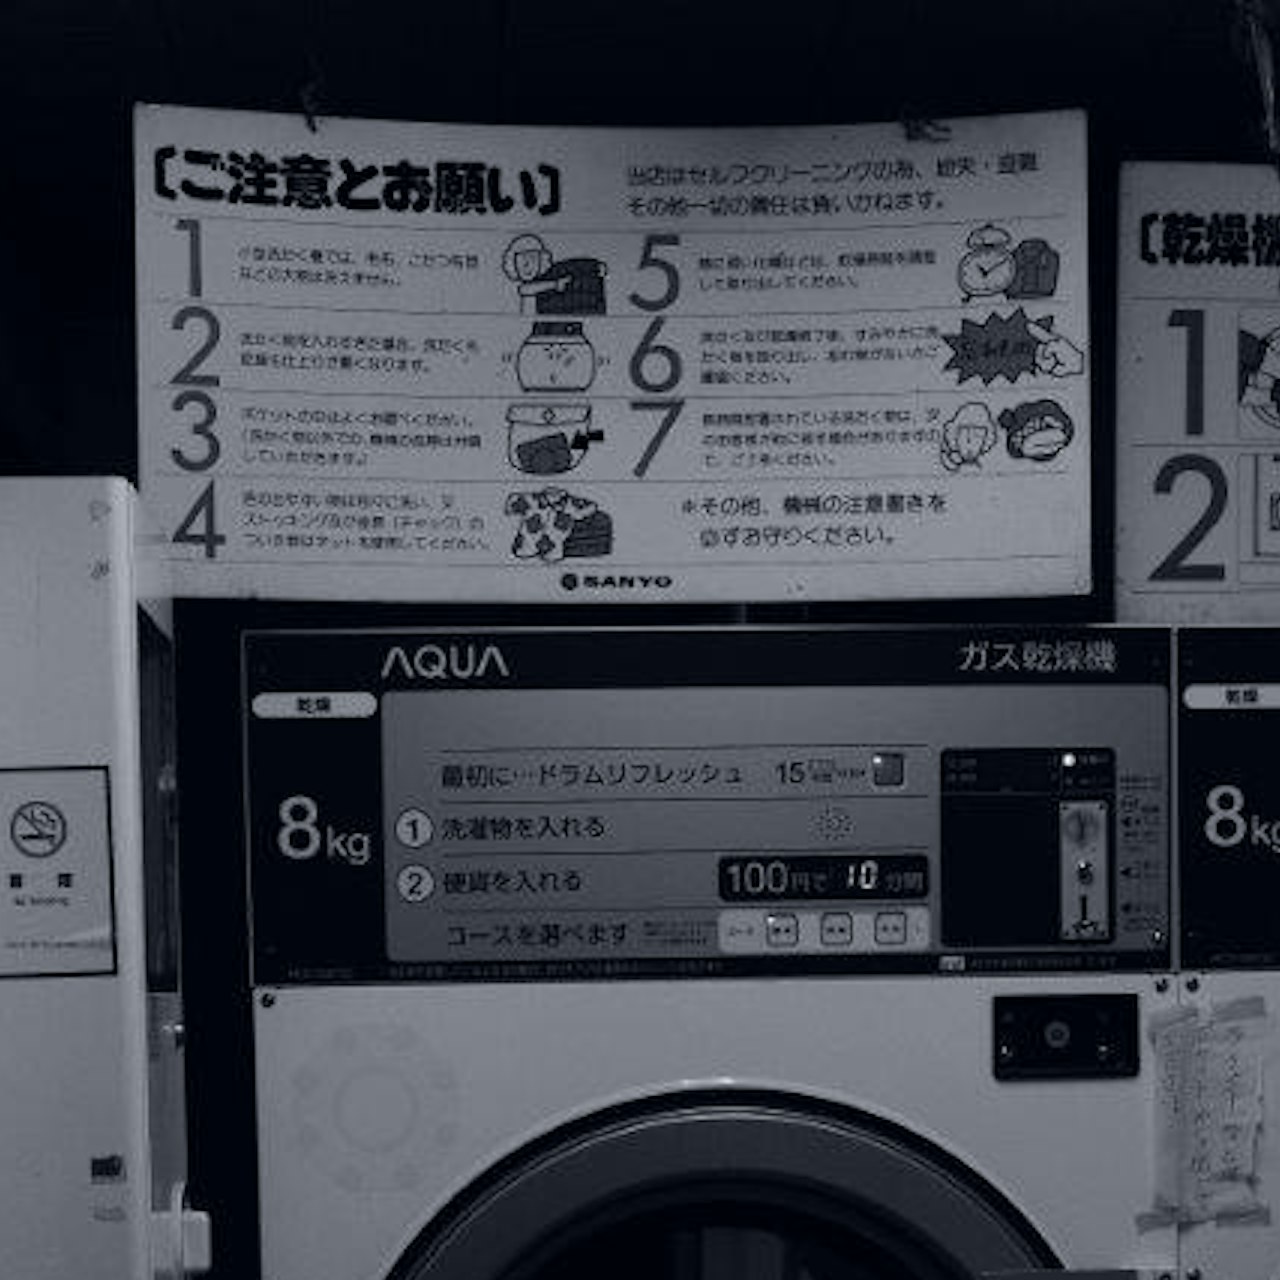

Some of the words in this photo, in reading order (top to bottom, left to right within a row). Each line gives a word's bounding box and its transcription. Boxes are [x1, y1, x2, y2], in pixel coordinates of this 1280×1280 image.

[175, 219, 202, 297] 1
[629, 234, 680, 312] 5
[171, 306, 221, 386] 2
[629, 316, 682, 393] 6
[1168, 309, 1205, 435] 1
[172, 390, 221, 472] 3
[630, 400, 686, 478] 7
[172, 479, 226, 559] 4
[1148, 453, 1228, 581] 2
[583, 574, 672, 589] SANYO
[381, 644, 511, 680] AQUA
[955, 639, 1120, 674] ガス乾燥機
[276, 793, 373, 867] 8kg
[441, 815, 607, 841] 洗濯物を入れる
[441, 870, 583, 895] 硬貨を入れる
[846, 859, 881, 892] 10
[447, 923, 629, 948] コースを選べます
